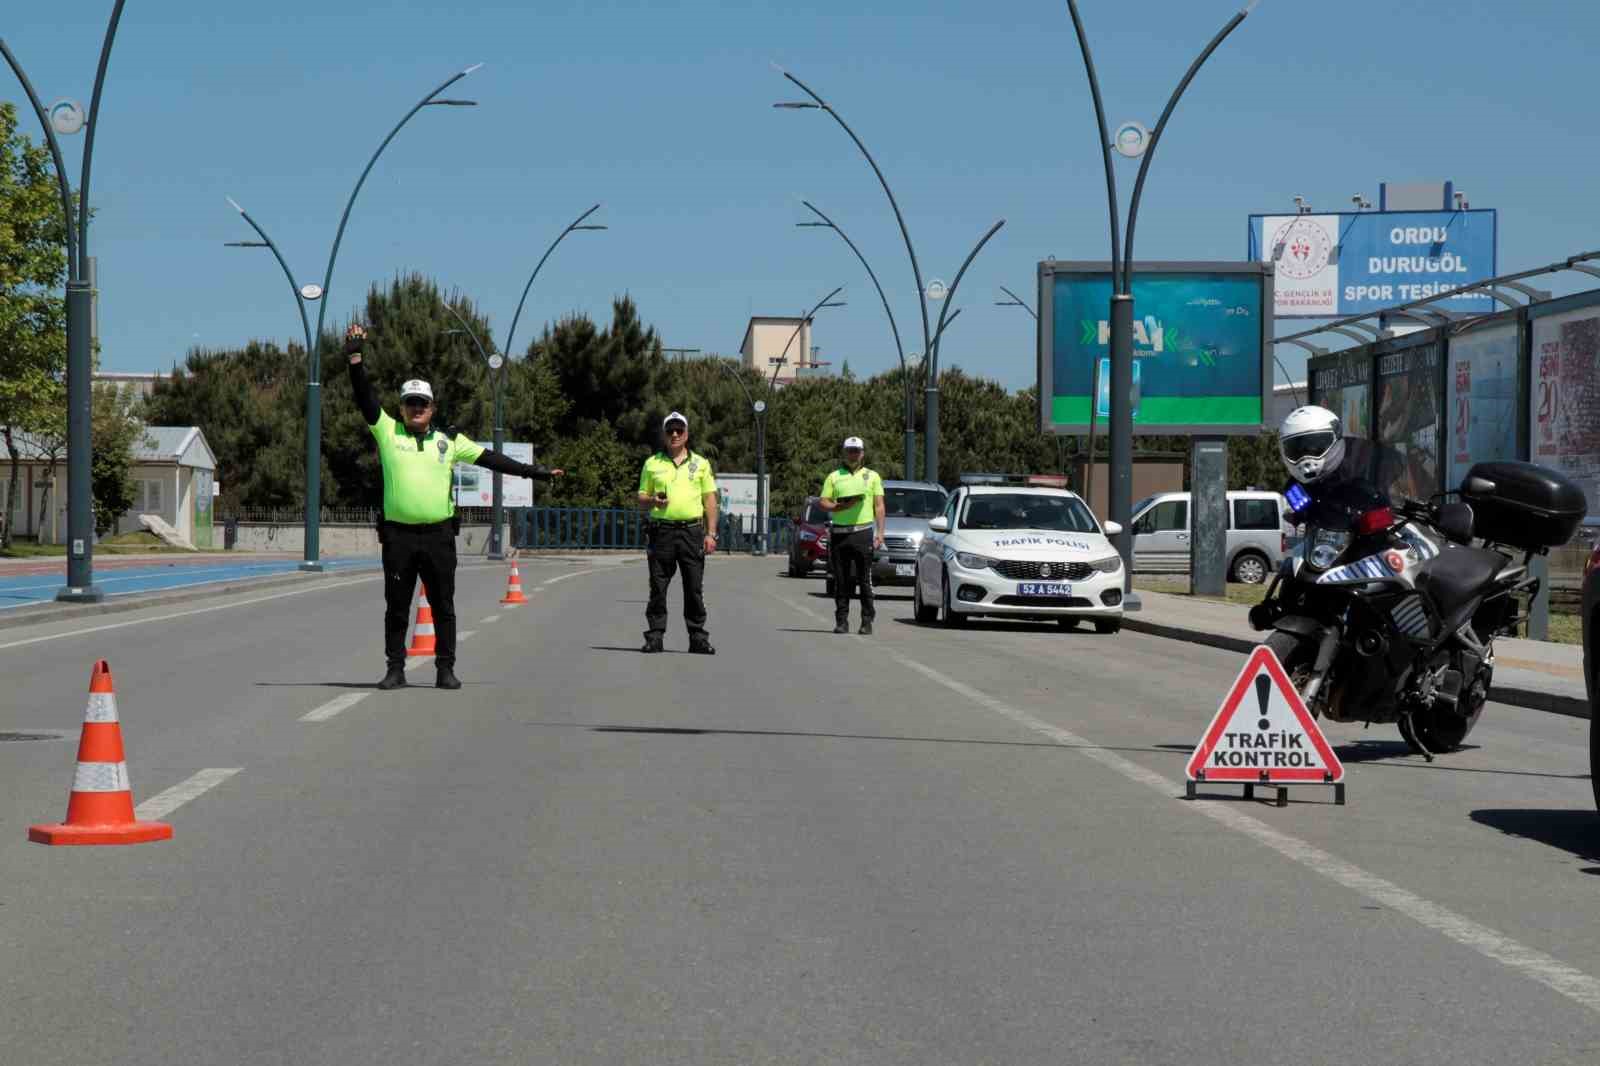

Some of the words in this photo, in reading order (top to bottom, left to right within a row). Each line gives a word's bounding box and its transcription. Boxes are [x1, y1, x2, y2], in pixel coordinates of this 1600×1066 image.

[1390, 227, 1447, 244] ORDU
[1368, 252, 1467, 273] DURUGÖL
[1344, 286, 1393, 301] SPOR
[1398, 281, 1492, 300] TESİS
[1023, 584, 1036, 594] 52
[1038, 584, 1045, 594] A
[1225, 730, 1303, 749] TRAFİK
[1214, 751, 1316, 767] KONTROL
